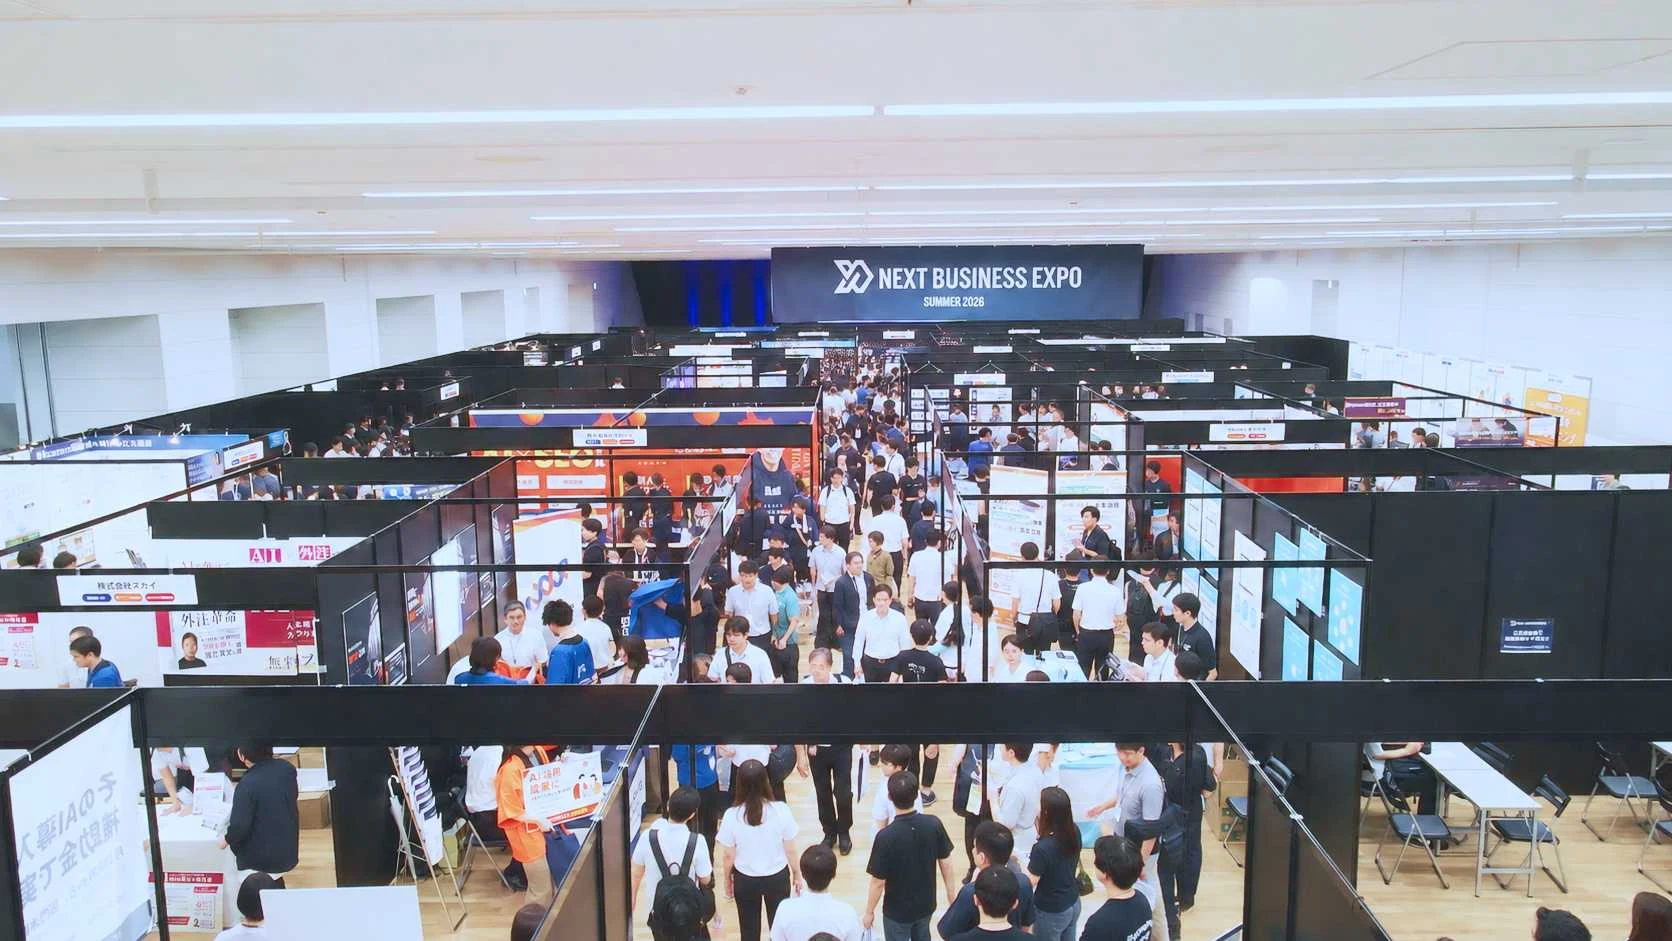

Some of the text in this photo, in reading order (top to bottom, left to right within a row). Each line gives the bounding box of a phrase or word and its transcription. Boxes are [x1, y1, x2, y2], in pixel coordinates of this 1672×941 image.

[878, 266, 1082, 290] NEXT BUSINESS EXPO
[923, 296, 985, 308] SUMMER 2026
[97, 581, 156, 591] 株式会社スカイ
